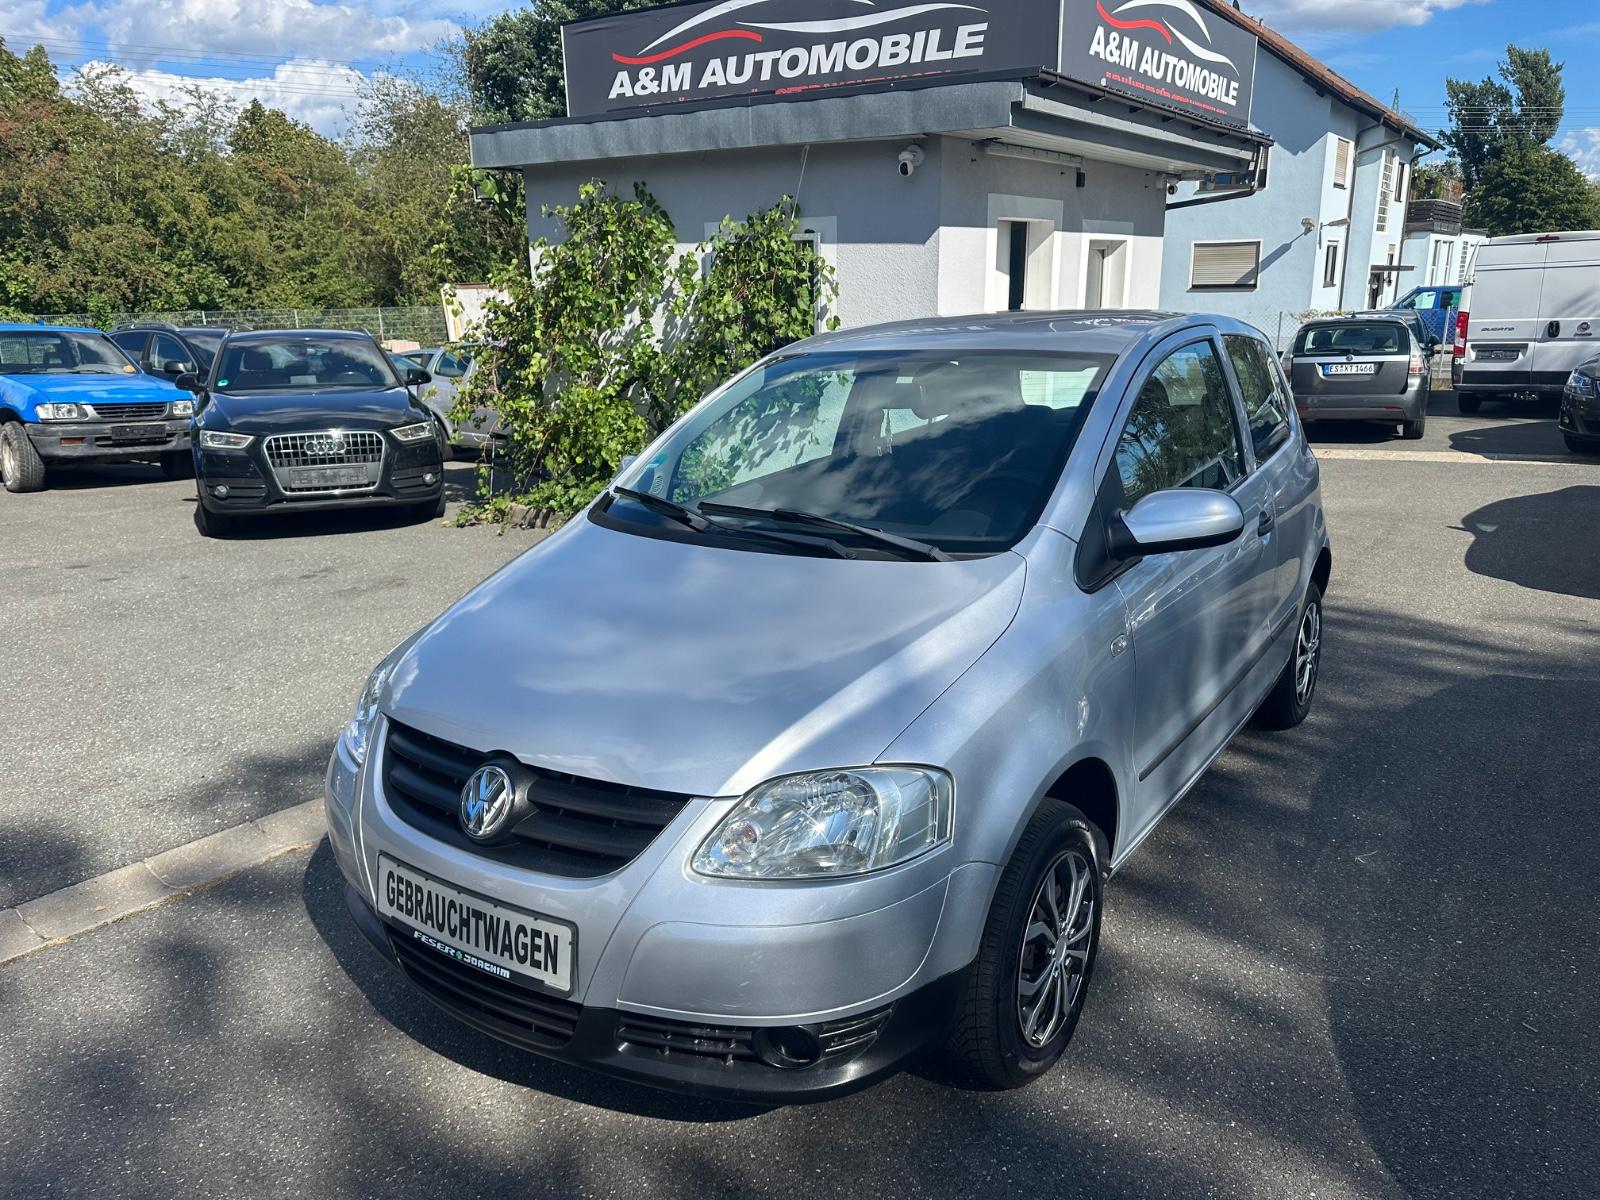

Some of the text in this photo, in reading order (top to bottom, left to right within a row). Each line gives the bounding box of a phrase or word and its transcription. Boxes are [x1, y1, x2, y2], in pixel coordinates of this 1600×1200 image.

[608, 63, 691, 99] A&M
[699, 22, 988, 88] AUTOMOBILE
[1089, 26, 1139, 70] A&M
[1139, 47, 1239, 106] AUTOMOBILE
[386, 870, 558, 975] GEBRAUCHTWAGEN
[413, 930, 510, 979] FESER JOACHIM
